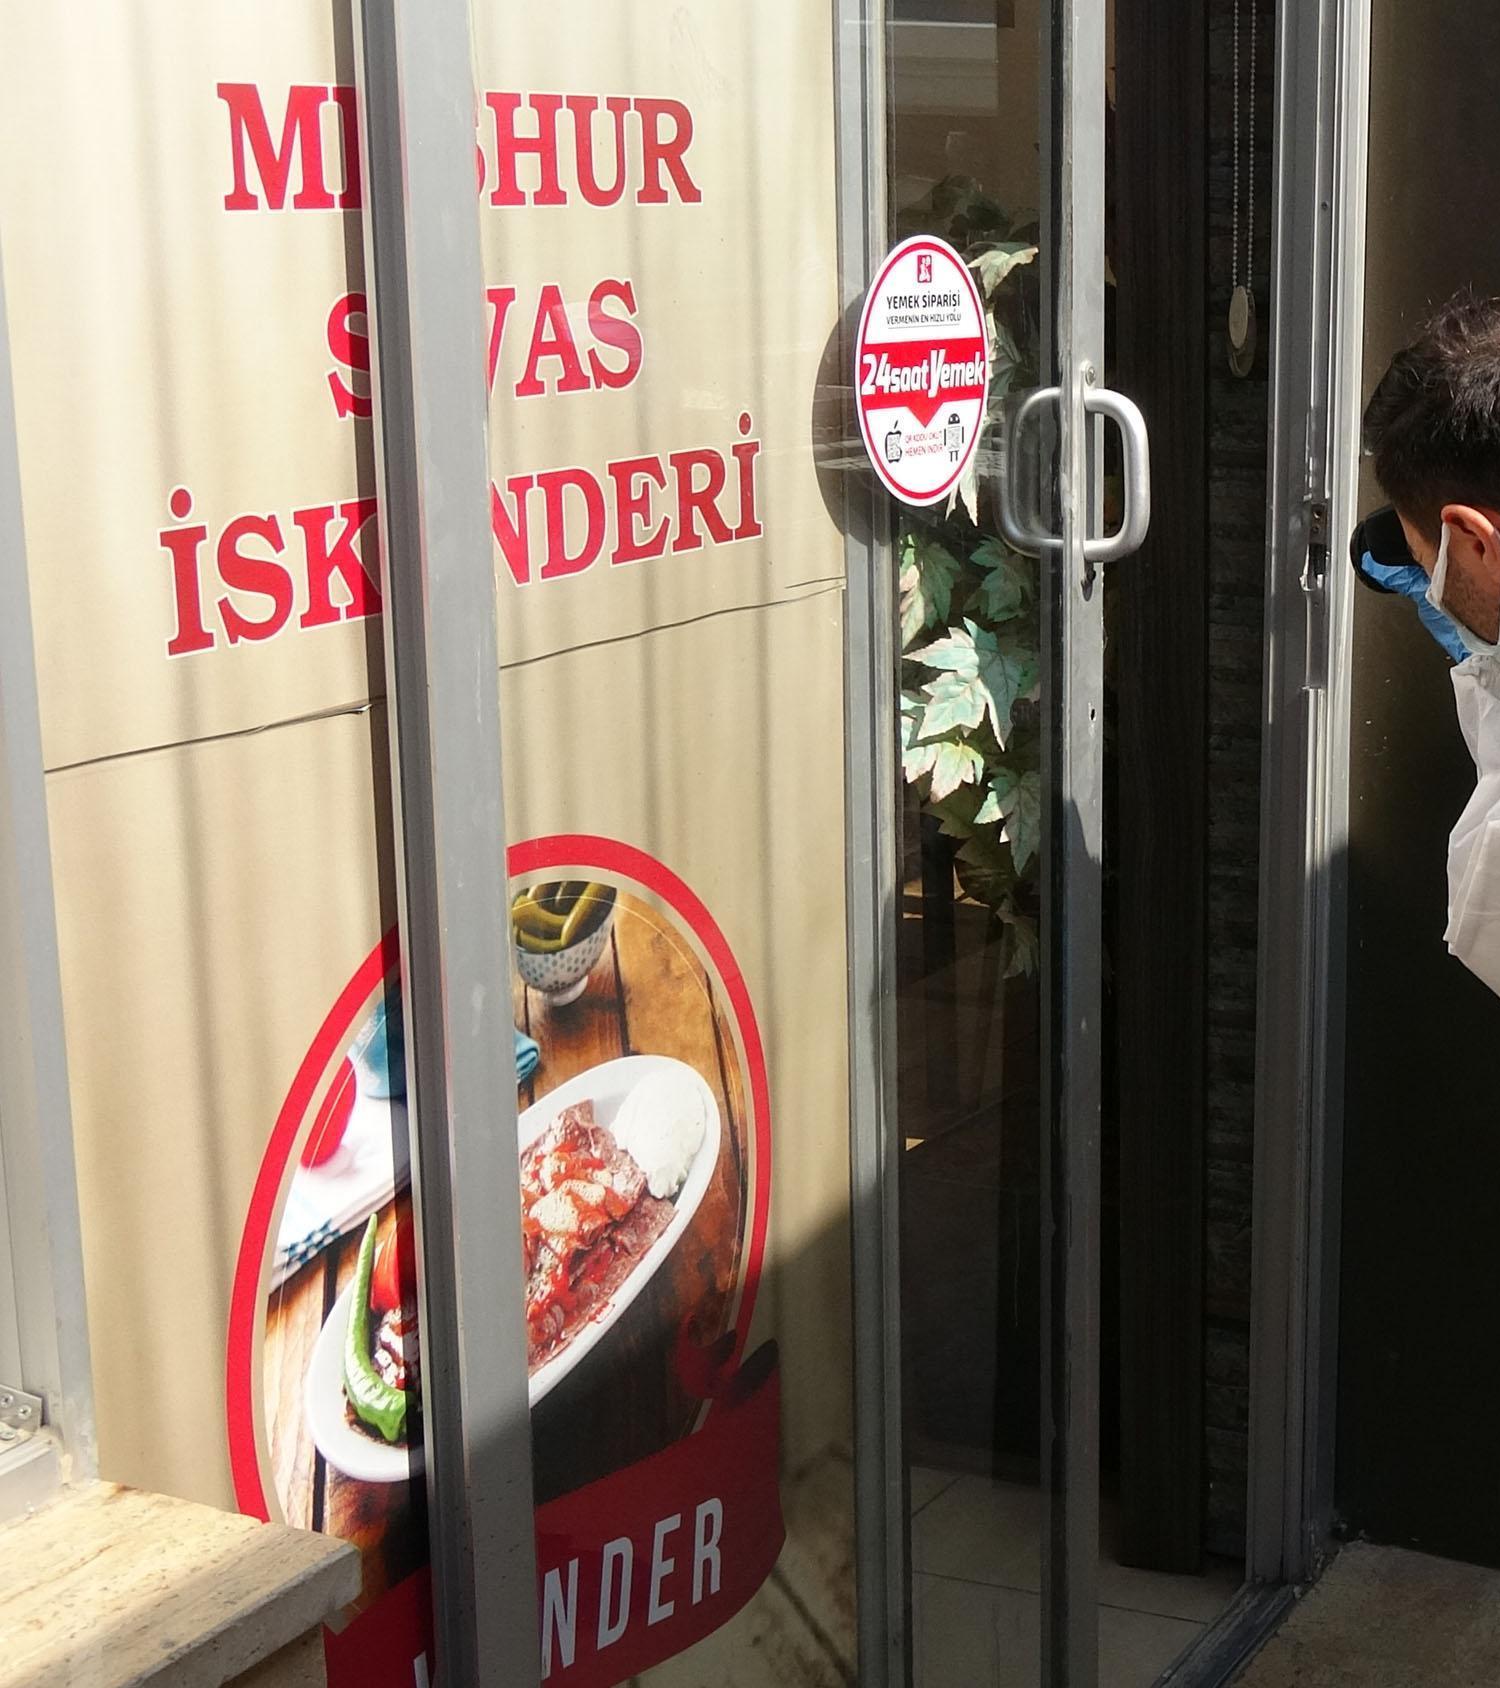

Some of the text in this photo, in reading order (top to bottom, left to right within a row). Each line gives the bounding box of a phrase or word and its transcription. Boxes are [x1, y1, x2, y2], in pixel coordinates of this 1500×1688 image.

[216, 82, 703, 211] MHUR
[327, 277, 645, 421] SAS
[886, 295, 920, 310] YEMEK
[921, 313, 929, 323] EN
[159, 412, 763, 657] İSKNDERİ
